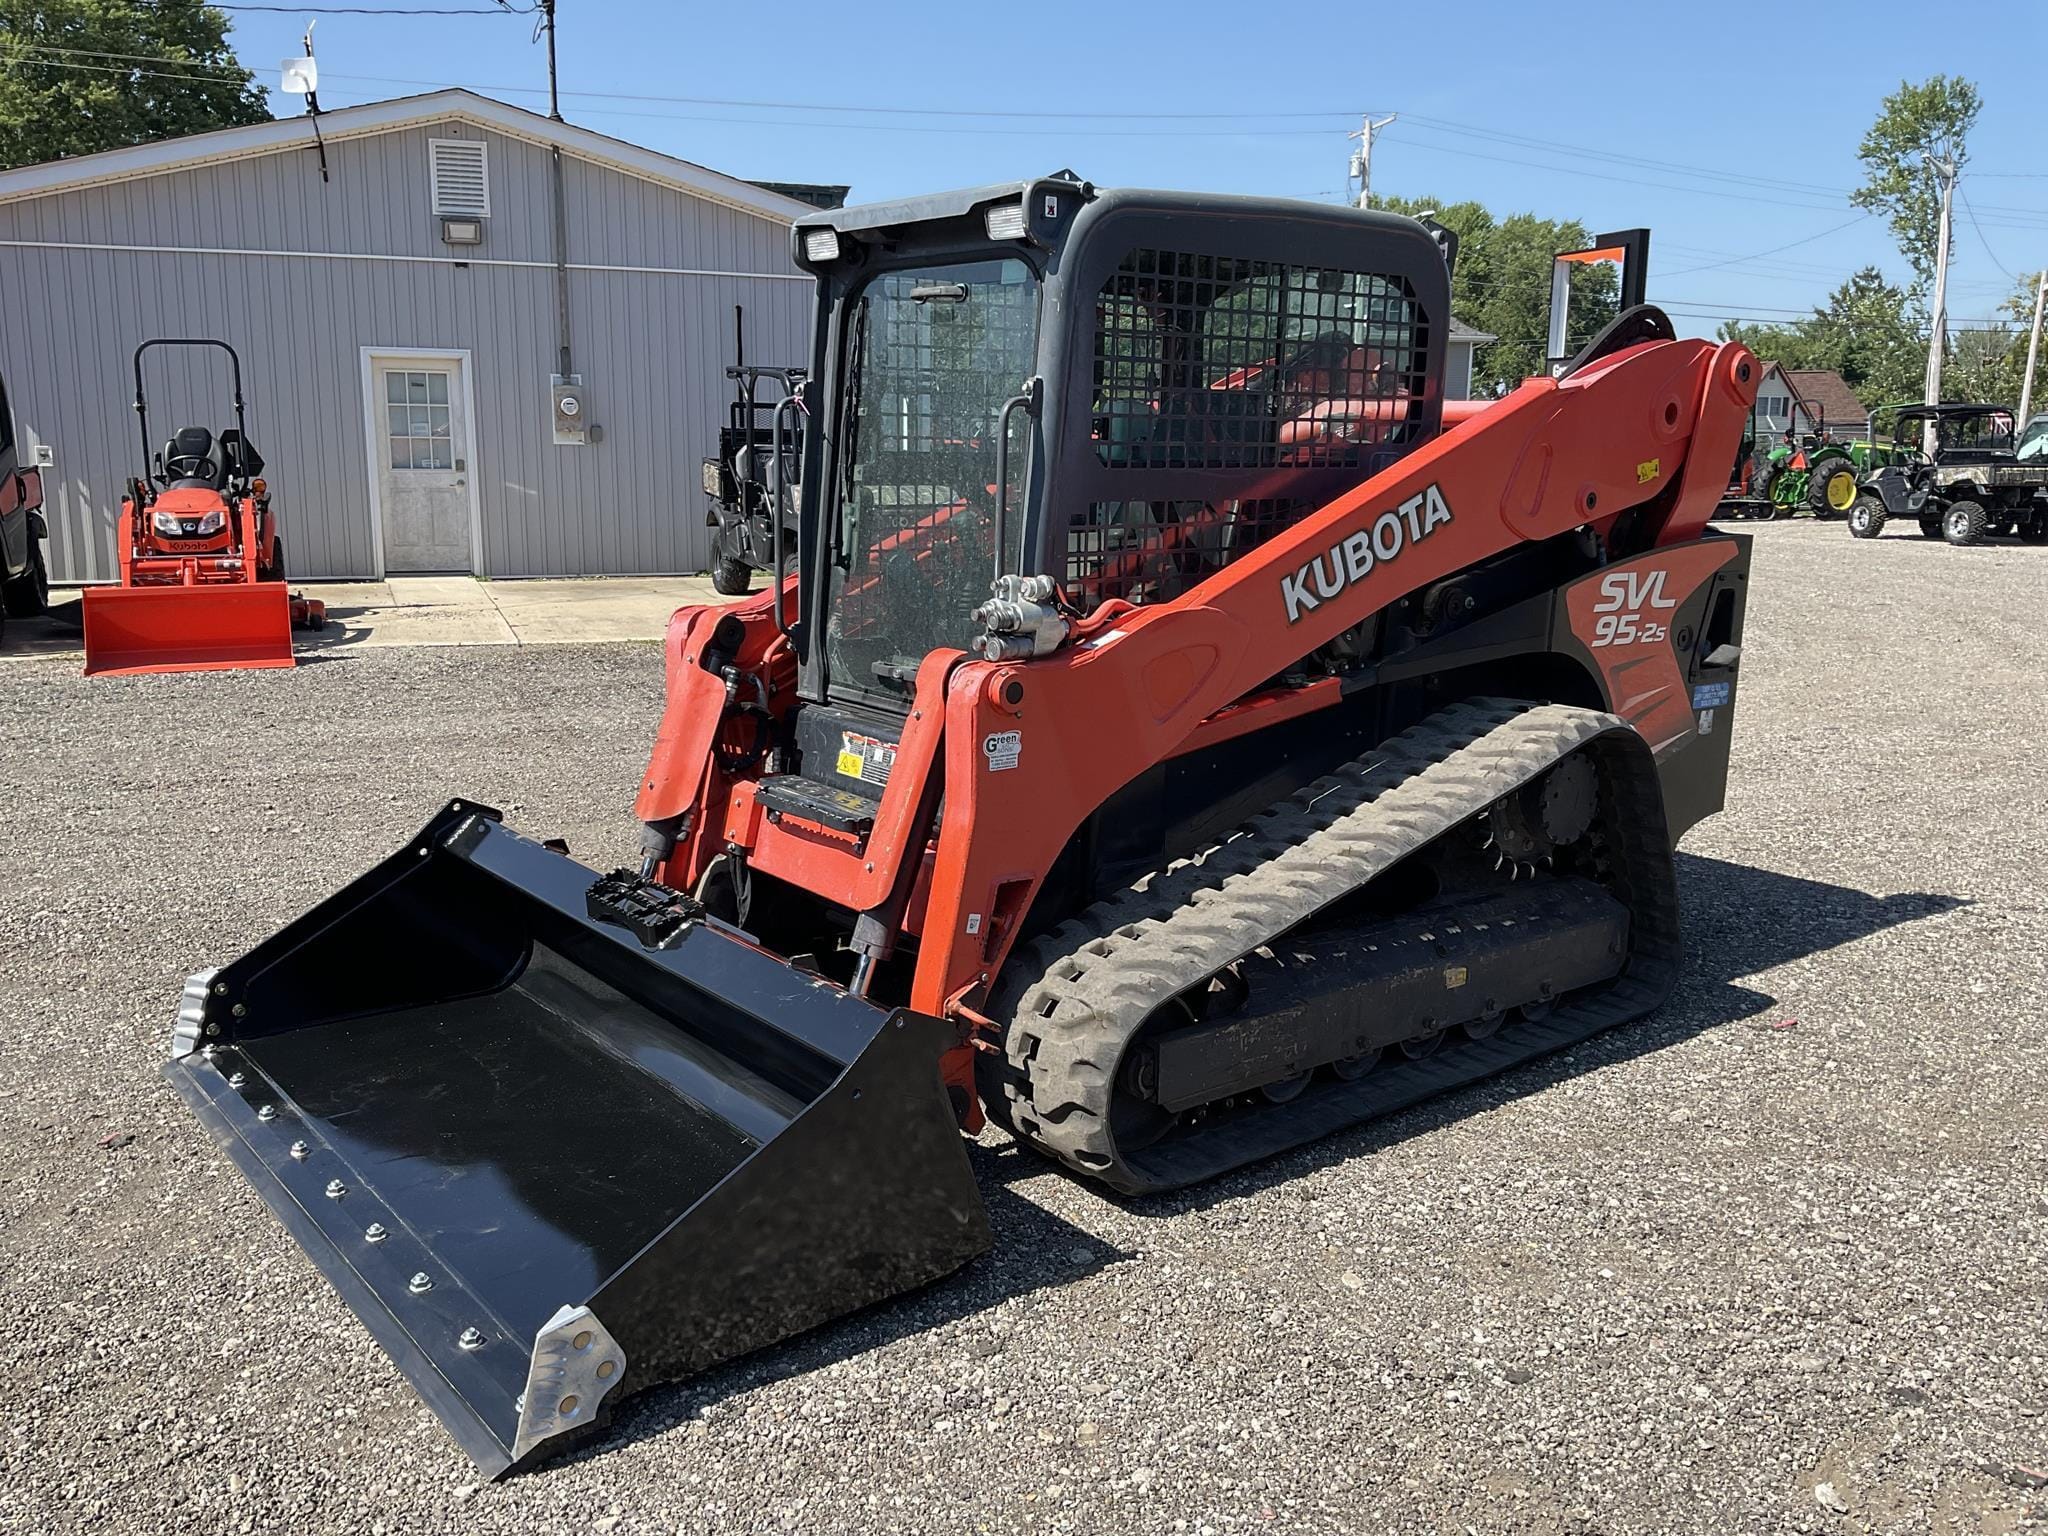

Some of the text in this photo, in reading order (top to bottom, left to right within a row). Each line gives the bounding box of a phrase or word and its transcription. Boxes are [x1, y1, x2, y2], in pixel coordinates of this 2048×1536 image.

[169, 541, 208, 551] Kubota
[1280, 483, 1452, 623] KUBOTA
[1592, 571, 1676, 613] SVL
[986, 735, 1017, 753] Green
